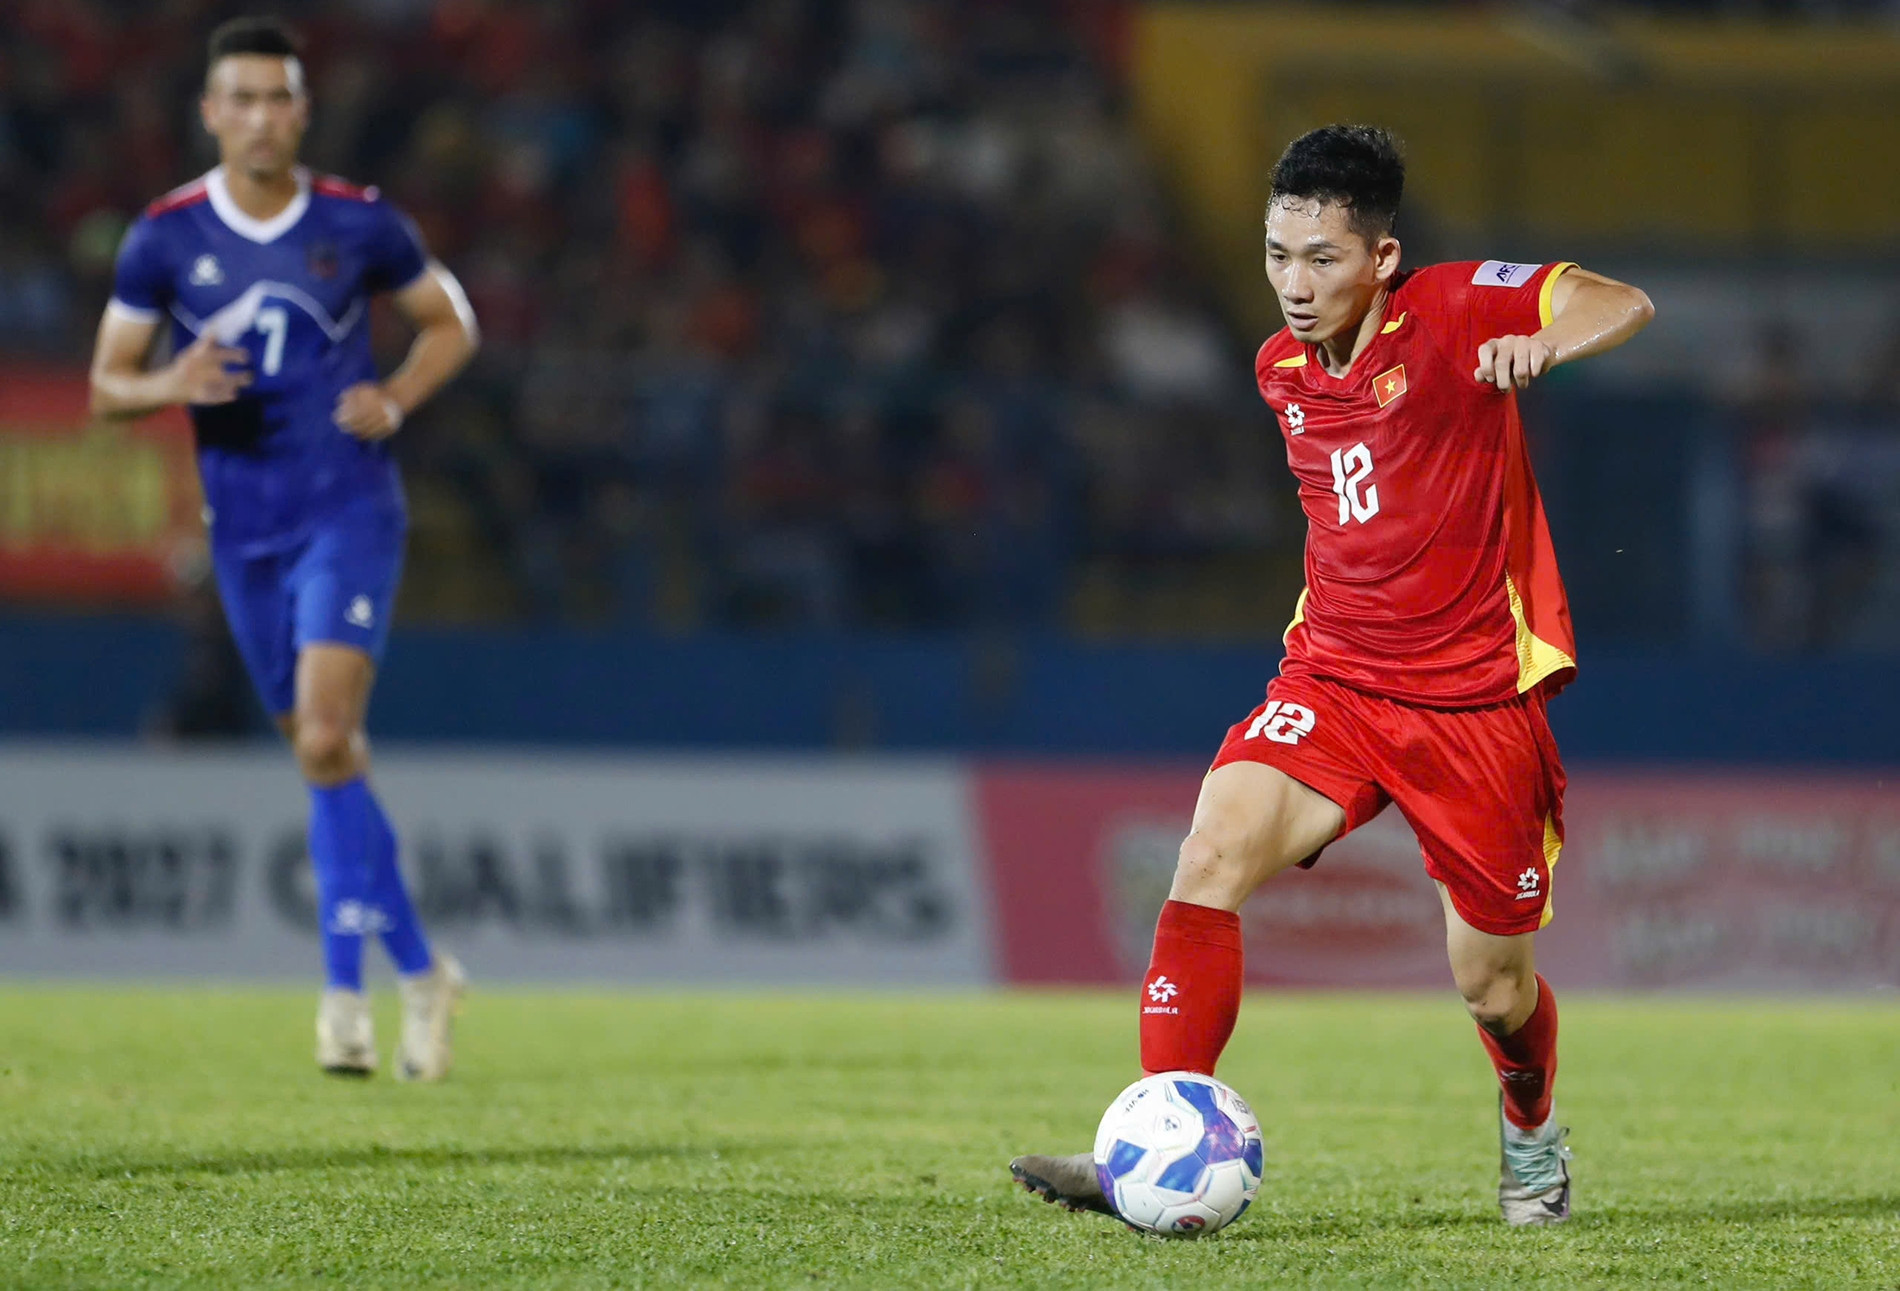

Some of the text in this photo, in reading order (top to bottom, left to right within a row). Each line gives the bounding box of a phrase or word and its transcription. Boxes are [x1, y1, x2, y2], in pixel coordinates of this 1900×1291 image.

[255, 305, 287, 376] 7
[1330, 441, 1380, 526] 12
[1244, 700, 1316, 745] 12
